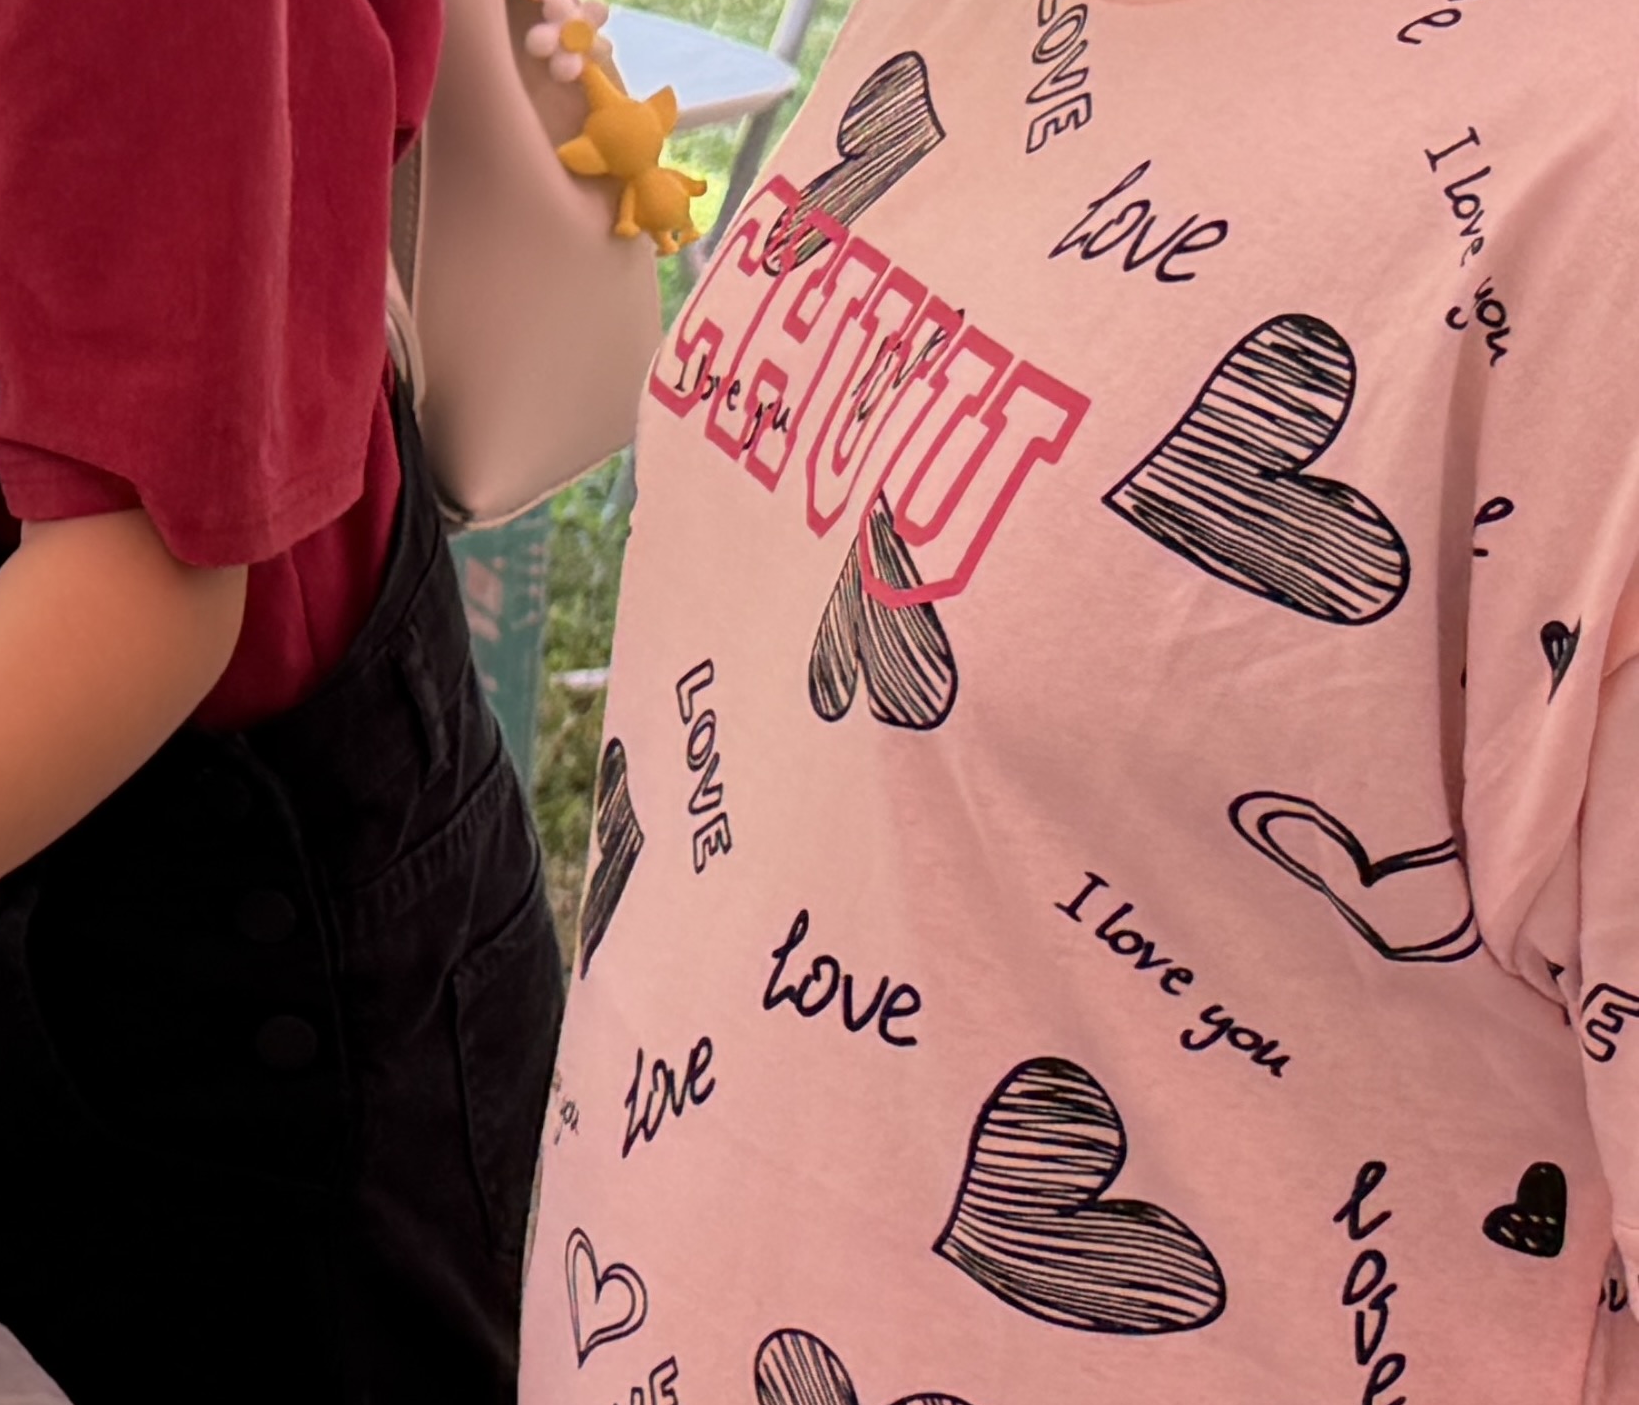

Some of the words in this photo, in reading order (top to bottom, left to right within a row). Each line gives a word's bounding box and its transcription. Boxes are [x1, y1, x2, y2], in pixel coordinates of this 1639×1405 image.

[1424, 127, 1481, 172] I
[1049, 160, 1230, 284] love
[1444, 166, 1493, 267] love
[1445, 277, 1510, 367] you
[675, 658, 733, 873] LOVE
[761, 910, 920, 1047] love
[1054, 869, 1107, 920] I
[1095, 902, 1194, 996] love
[1178, 1000, 1292, 1079] you
[622, 1036, 717, 1159] love
